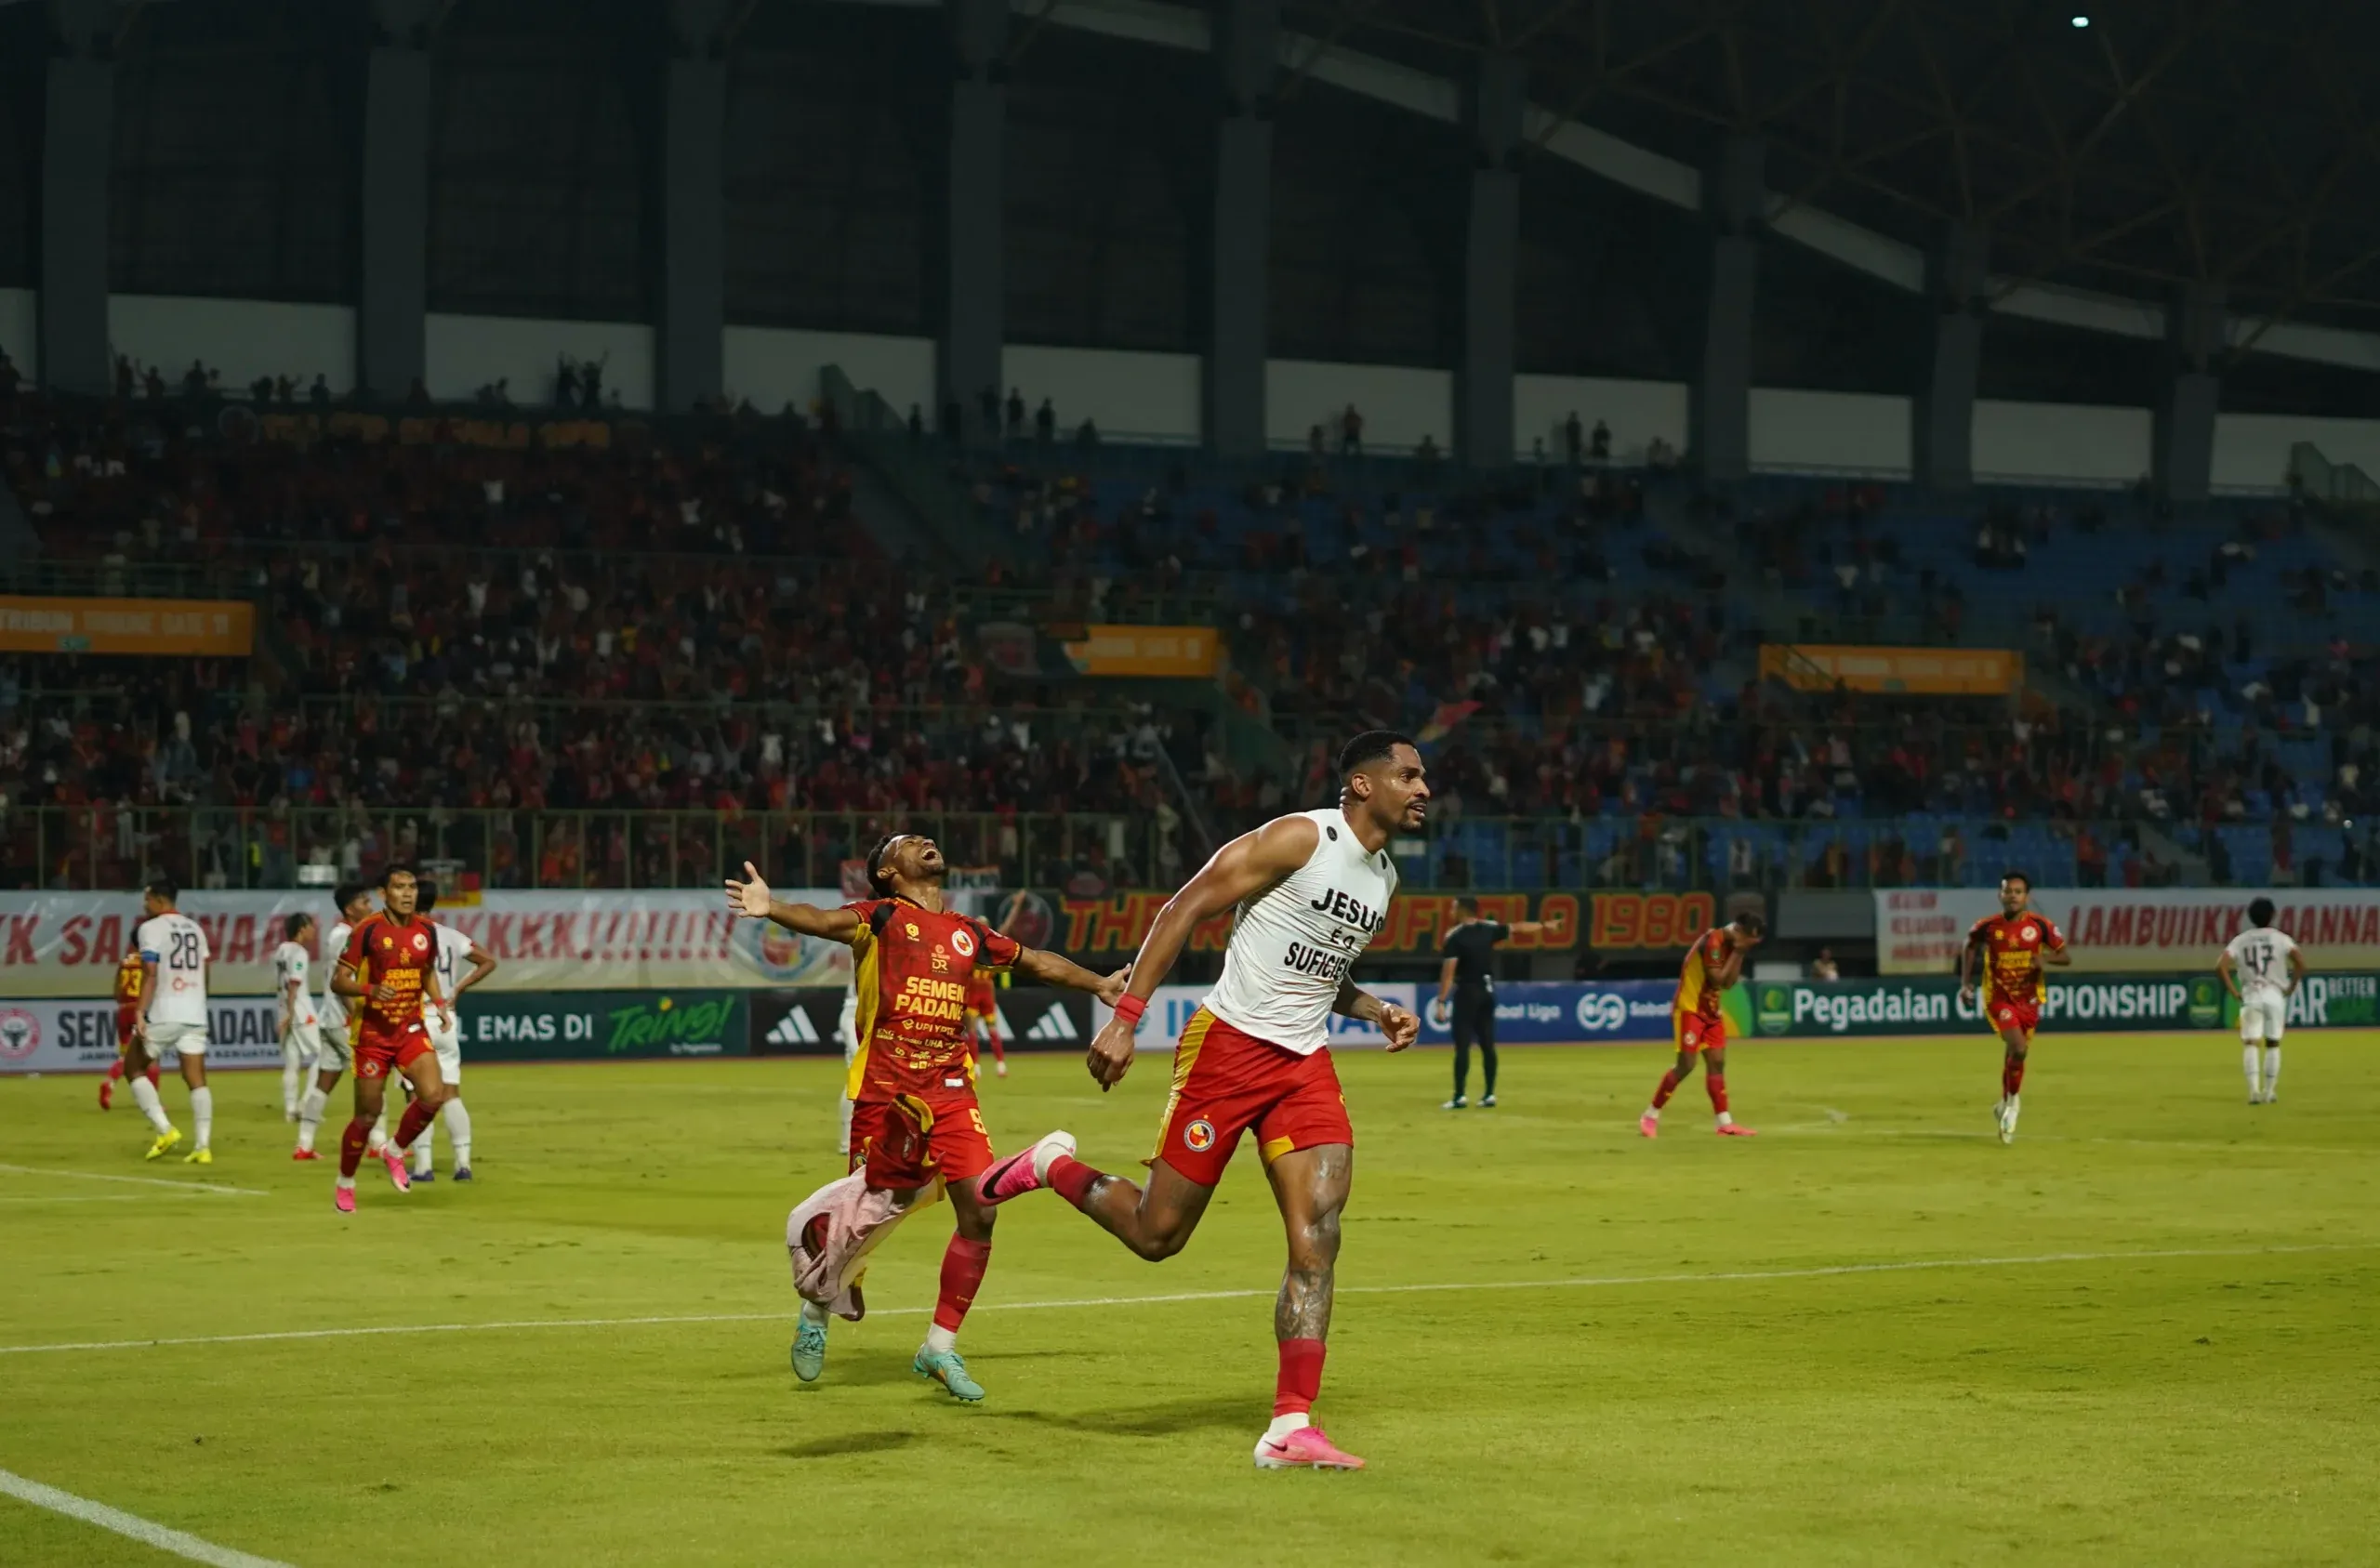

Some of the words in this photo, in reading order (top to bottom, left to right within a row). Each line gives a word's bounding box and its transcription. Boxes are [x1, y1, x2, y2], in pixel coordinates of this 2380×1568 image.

[1589, 889, 1716, 950] 1980
[170, 931, 199, 970] 28
[2243, 944, 2273, 976] 47
[906, 976, 966, 1004] SEMEN
[1794, 987, 1948, 1031] Pegadaian
[477, 1013, 556, 1042] EMAS
[563, 1012, 593, 1041] DI
